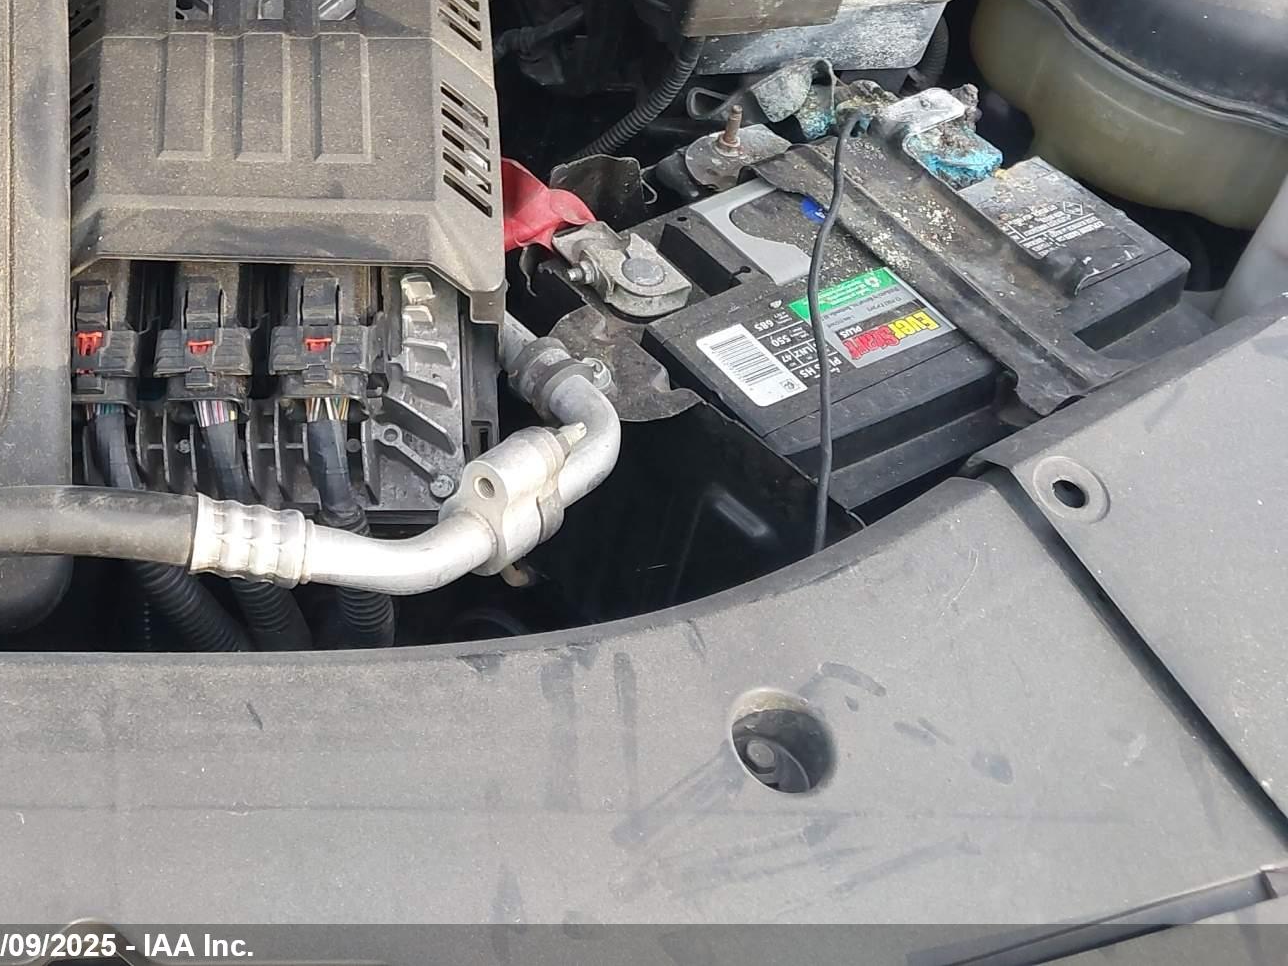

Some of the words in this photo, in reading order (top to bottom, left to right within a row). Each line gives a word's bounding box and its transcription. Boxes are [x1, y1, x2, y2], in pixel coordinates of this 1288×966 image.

[754, 319, 775, 332] 685
[839, 324, 863, 340] PLUS
[770, 334, 792, 347] 550
[841, 308, 942, 361] EverStart
